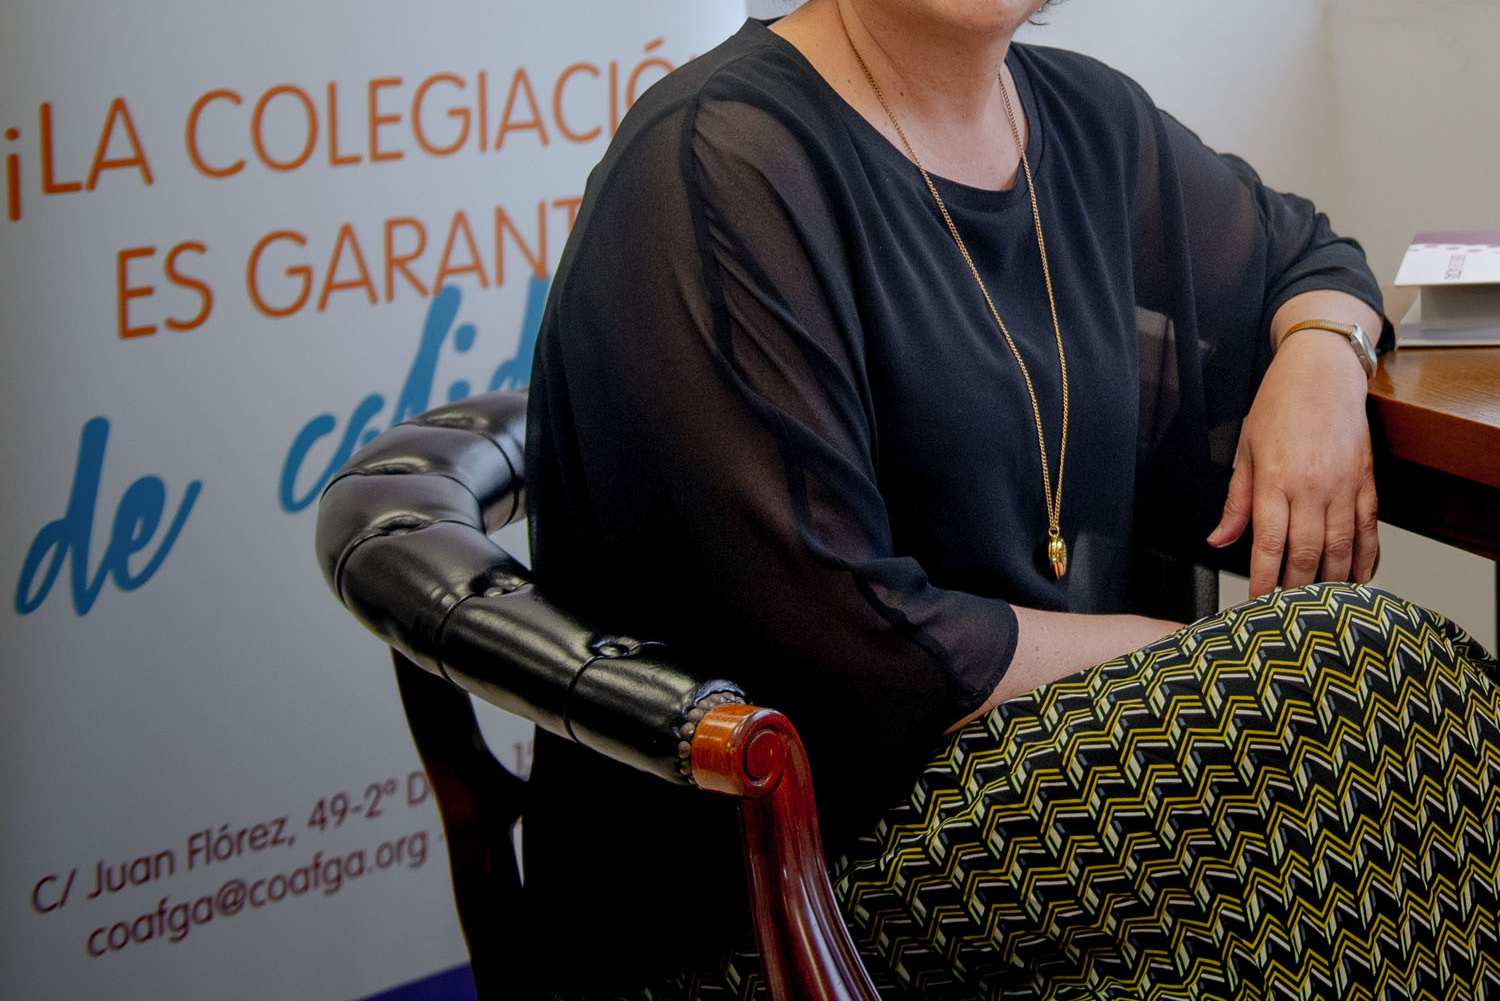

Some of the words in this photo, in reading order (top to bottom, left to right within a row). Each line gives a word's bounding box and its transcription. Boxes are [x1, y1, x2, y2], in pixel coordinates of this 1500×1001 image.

[184, 38, 699, 179] COLEGIACIÓ
[116, 240, 214, 340] ES
[14, 416, 203, 617] de
[30, 870, 77, 915] C/
[86, 846, 175, 900] Juan
[186, 816, 298, 871] Flórez,
[86, 828, 431, 958] coafga@coafga.org
